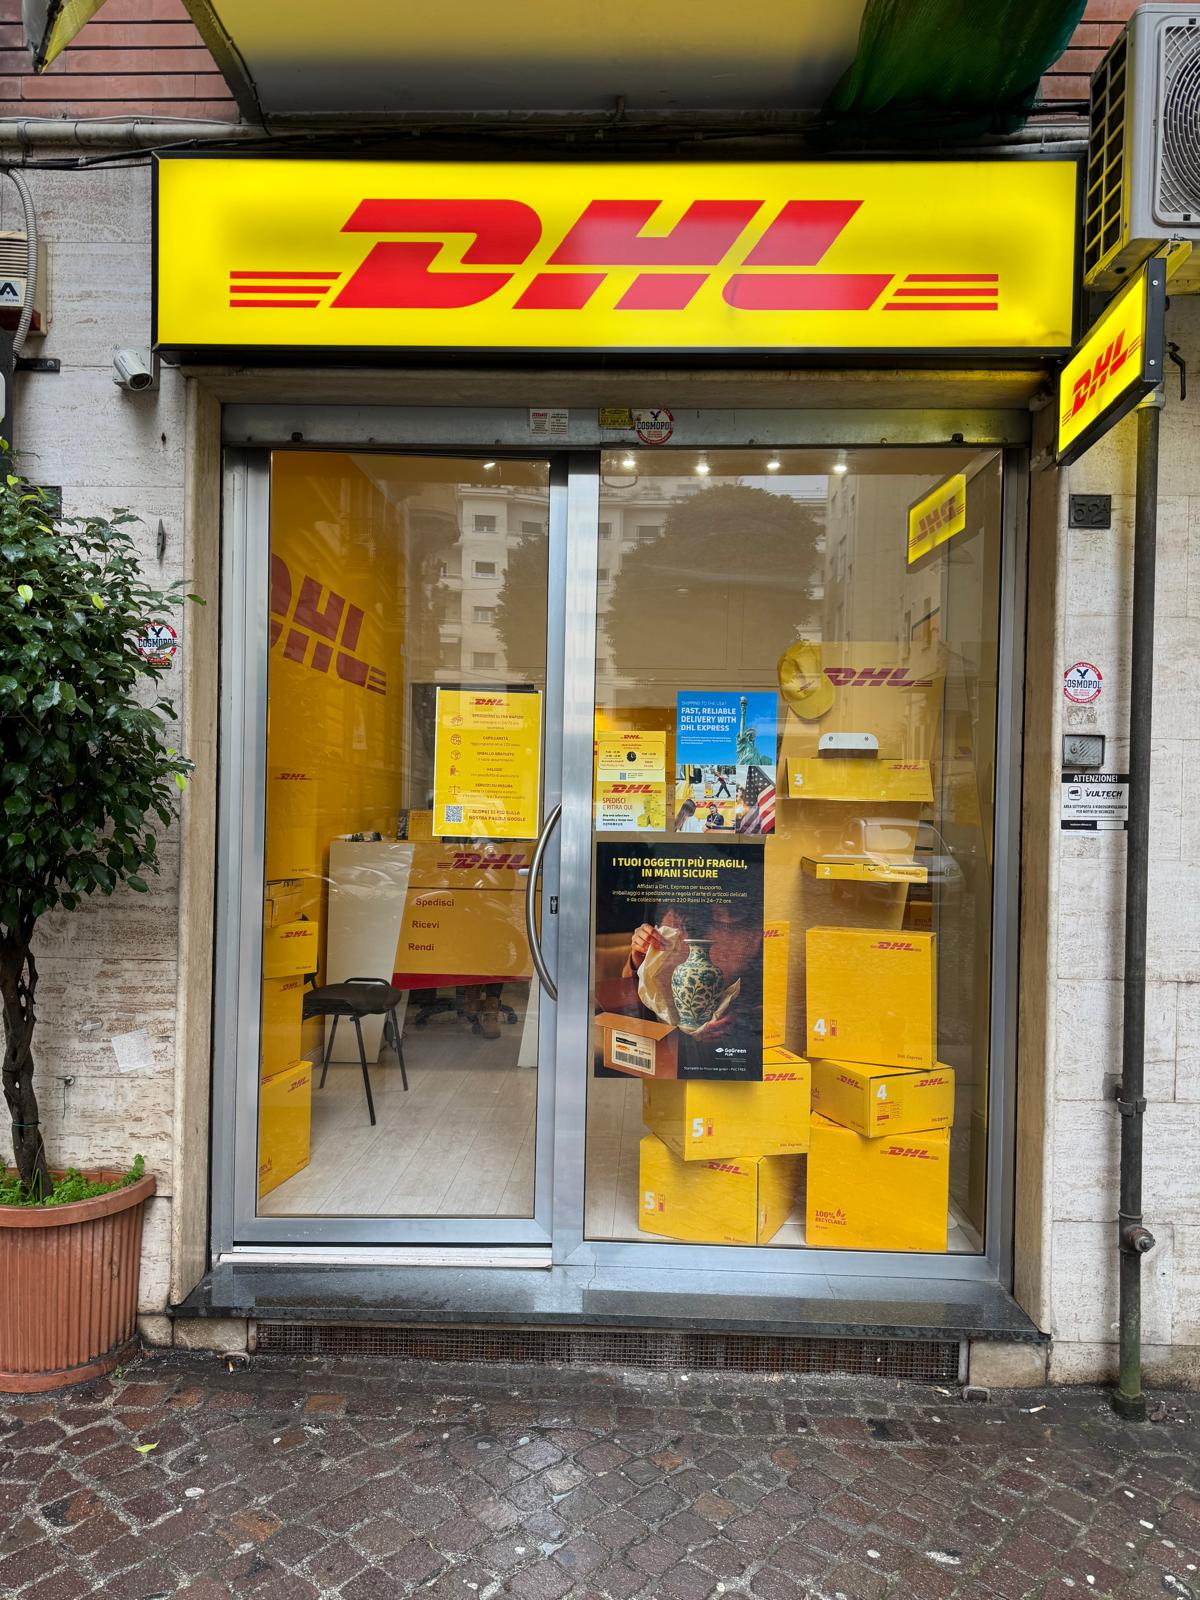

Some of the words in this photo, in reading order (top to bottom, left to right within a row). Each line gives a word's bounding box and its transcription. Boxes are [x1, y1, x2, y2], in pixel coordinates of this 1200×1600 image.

[329, 198, 896, 310] DHL
[1072, 328, 1129, 417] DHL
[823, 667, 914, 687] DHL
[474, 698, 504, 706] DHL
[681, 707, 701, 715] FAST,
[793, 773, 804, 785] 3
[1073, 774, 1118, 783] ATTENZIONE!
[611, 783, 654, 793] DHL
[453, 852, 531, 870] DHL
[617, 857, 641, 867] TUOI
[643, 858, 686, 868] OGGETTI
[687, 856, 704, 868] PIÙ
[706, 858, 748, 870] FRAGILI,
[641, 868, 653, 877] IN
[654, 868, 681, 878] MANI
[682, 869, 719, 879] SICURE
[823, 866, 831, 875] 2
[415, 898, 455, 908] Spedisci
[411, 920, 440, 929] Ricevi
[285, 929, 308, 938] DHL
[408, 942, 435, 951] Rendi
[878, 941, 914, 951] DHL
[813, 1018, 827, 1036] 4
[763, 1072, 797, 1082] DHL
[839, 1074, 861, 1089] DHL
[919, 1077, 945, 1087] DHL
[876, 1083, 887, 1100] 4
[691, 1117, 704, 1137] 5
[888, 1146, 931, 1159] DHL
[707, 1161, 742, 1175] DHL
[643, 1191, 656, 1210] 5
[815, 1209, 836, 1220] 100%
[815, 1216, 847, 1227] RECYCLABLE
